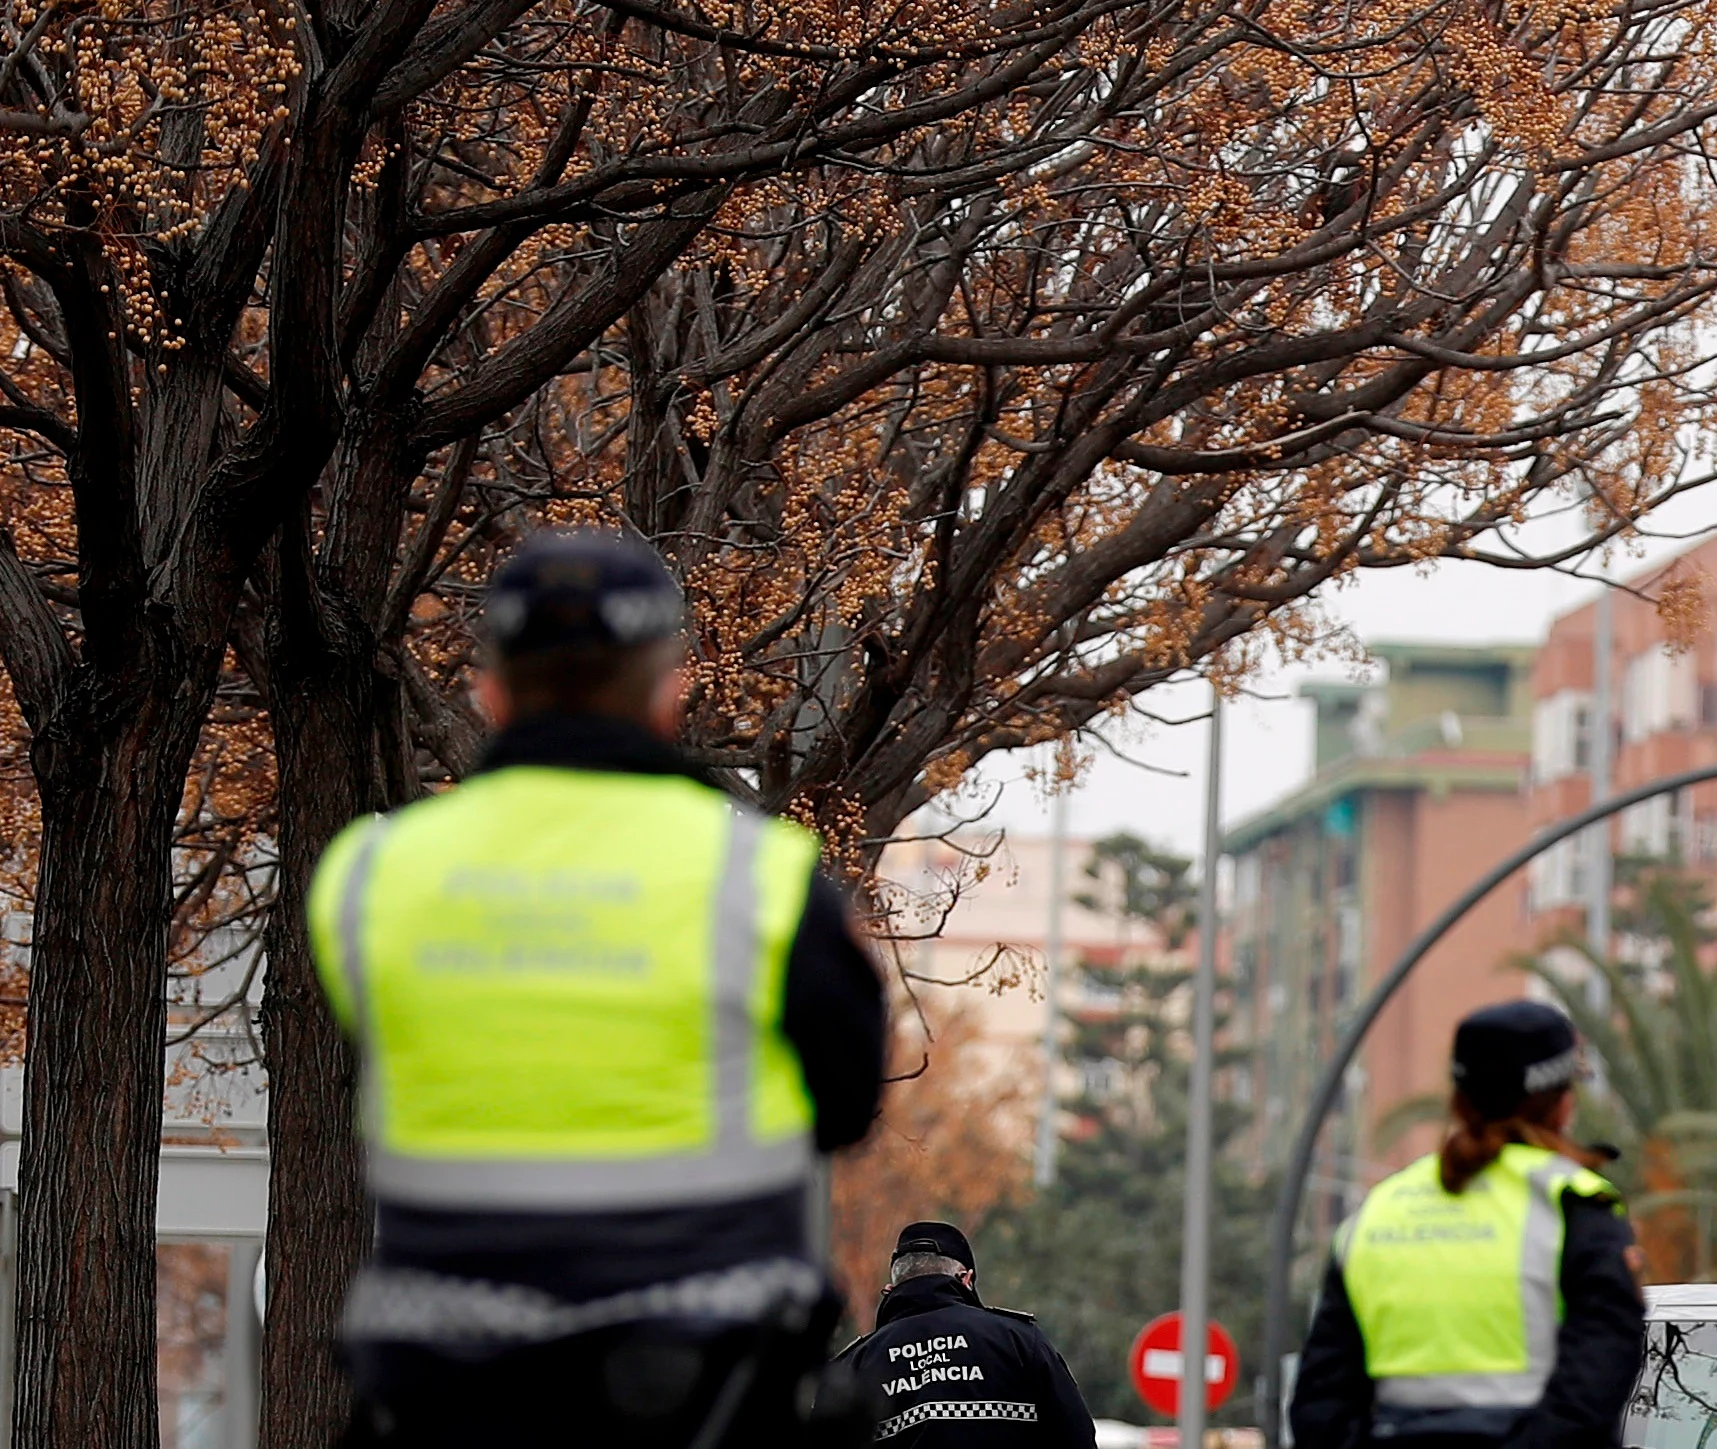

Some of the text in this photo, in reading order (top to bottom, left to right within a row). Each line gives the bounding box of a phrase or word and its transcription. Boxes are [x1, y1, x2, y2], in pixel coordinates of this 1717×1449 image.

[888, 1335, 968, 1362] POLICIA
[910, 1352, 950, 1371] LOCAL
[882, 1365, 984, 1397] VALÈNCIA
